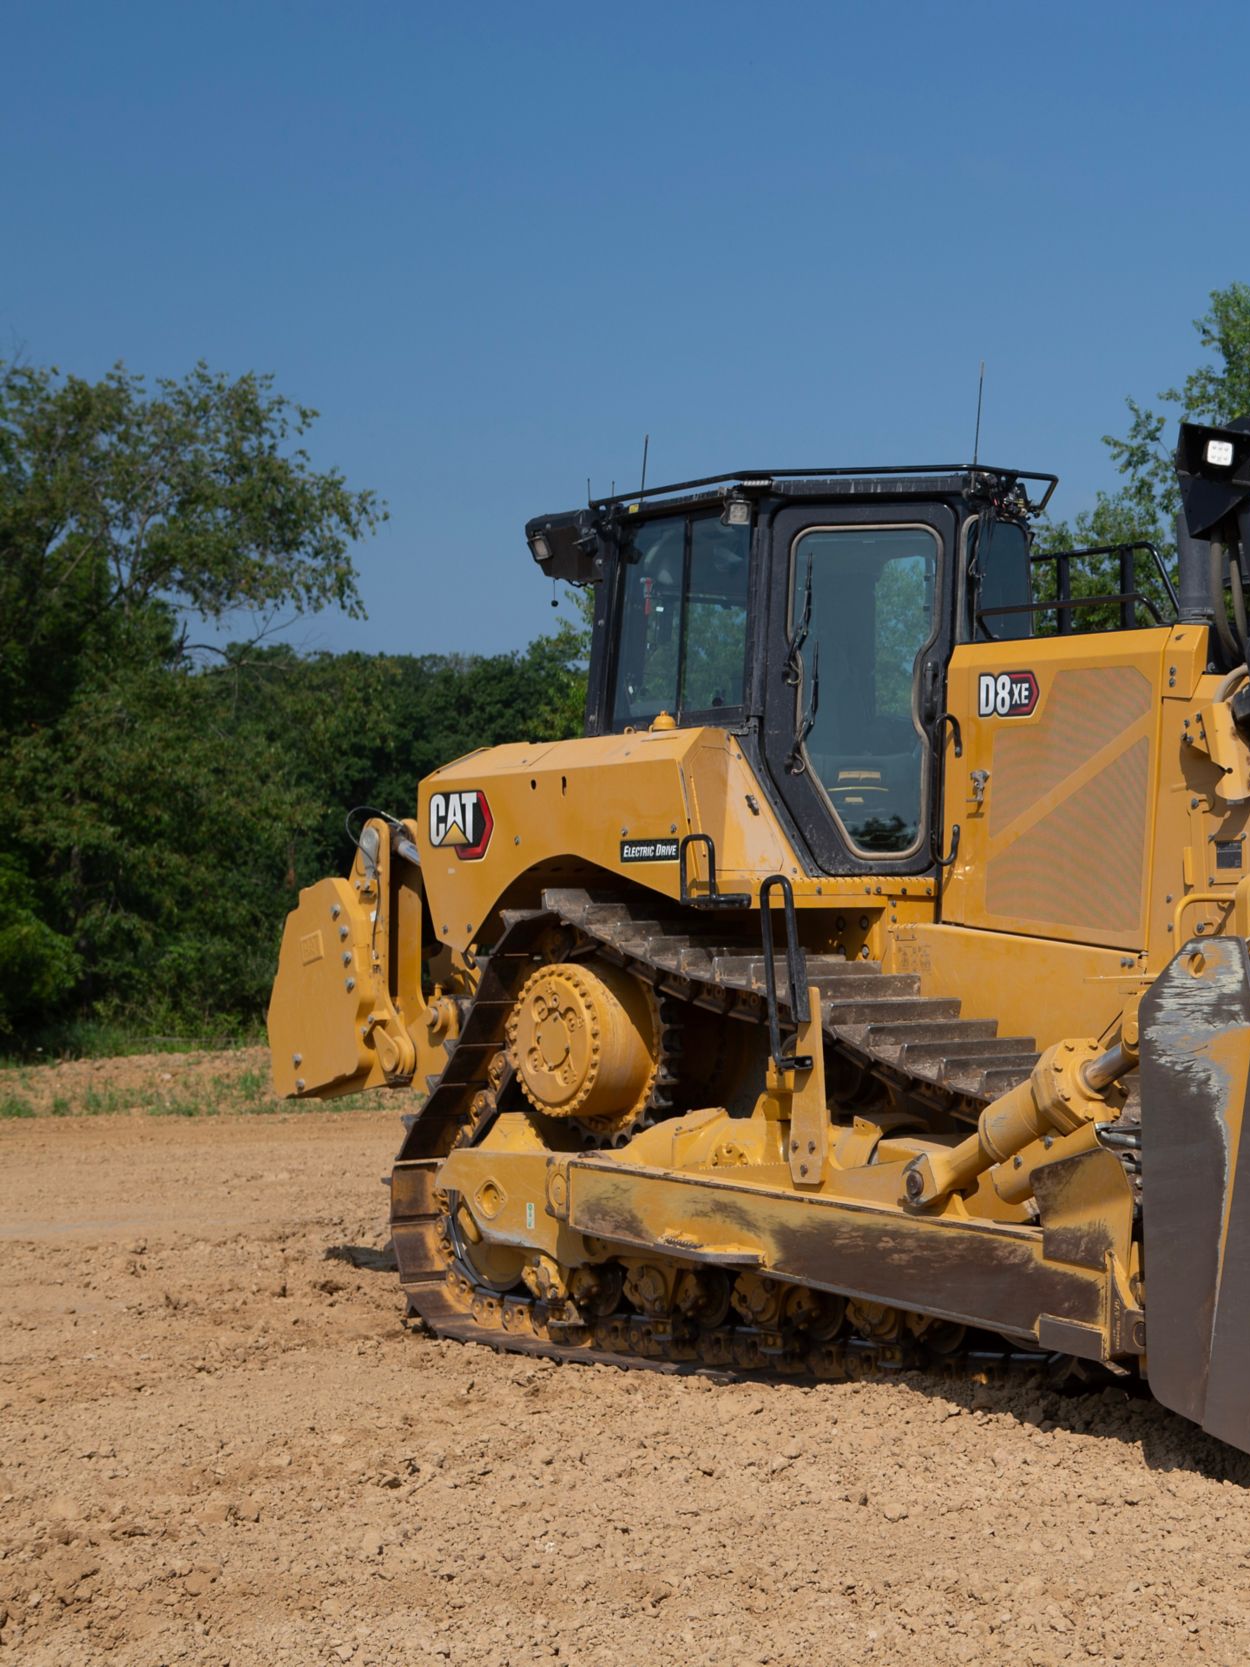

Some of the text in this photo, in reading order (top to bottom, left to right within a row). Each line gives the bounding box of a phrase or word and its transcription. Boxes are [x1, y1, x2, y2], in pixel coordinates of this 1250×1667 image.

[430, 792, 477, 846] CAT
[623, 844, 677, 858] ELECTRIC DRIVE
